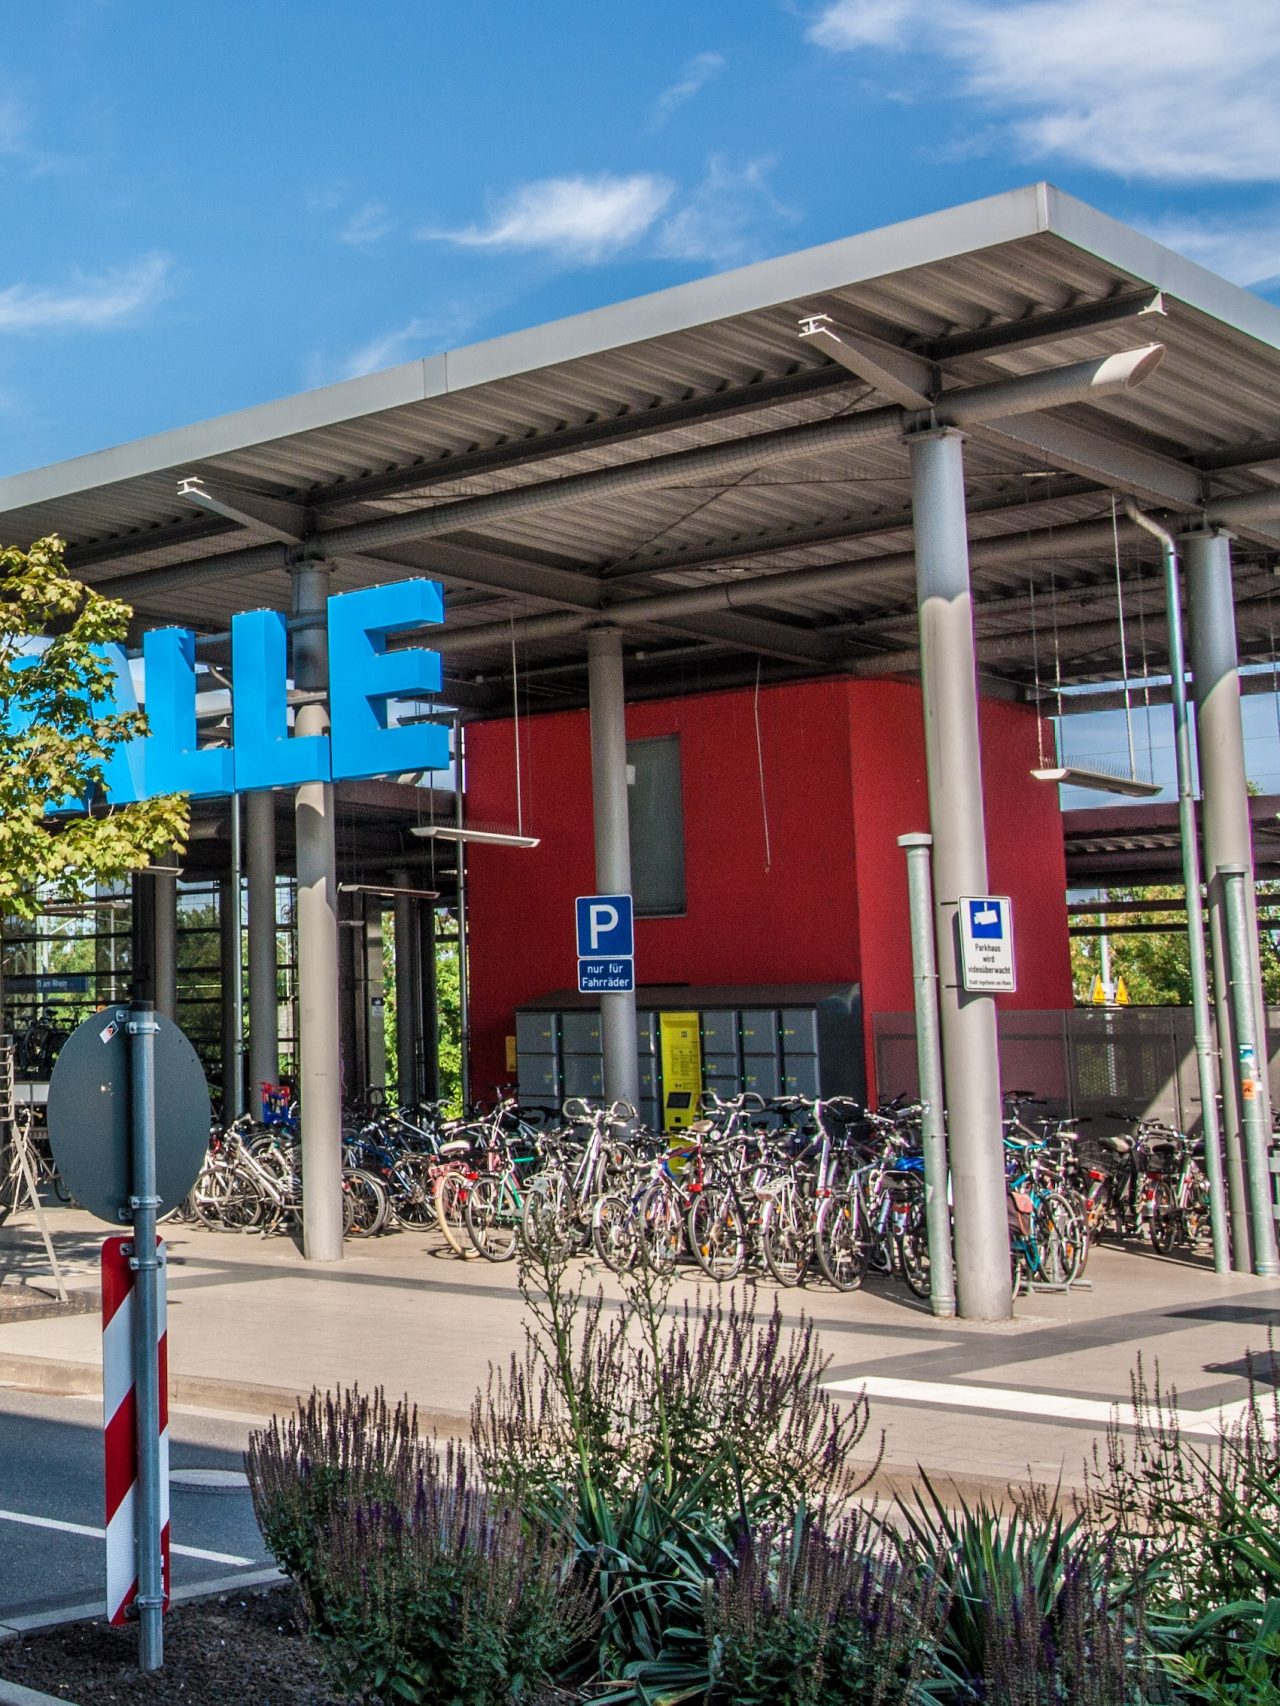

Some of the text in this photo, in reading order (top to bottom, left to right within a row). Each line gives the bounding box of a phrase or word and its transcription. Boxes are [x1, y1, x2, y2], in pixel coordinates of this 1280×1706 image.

[589, 904, 619, 949] P
[975, 943, 1001, 952] Parkhaus
[982, 955, 995, 963] wird
[587, 963, 624, 973] nur für
[968, 966, 1010, 974] videoüberwacht
[582, 977, 630, 987] Fahrräder
